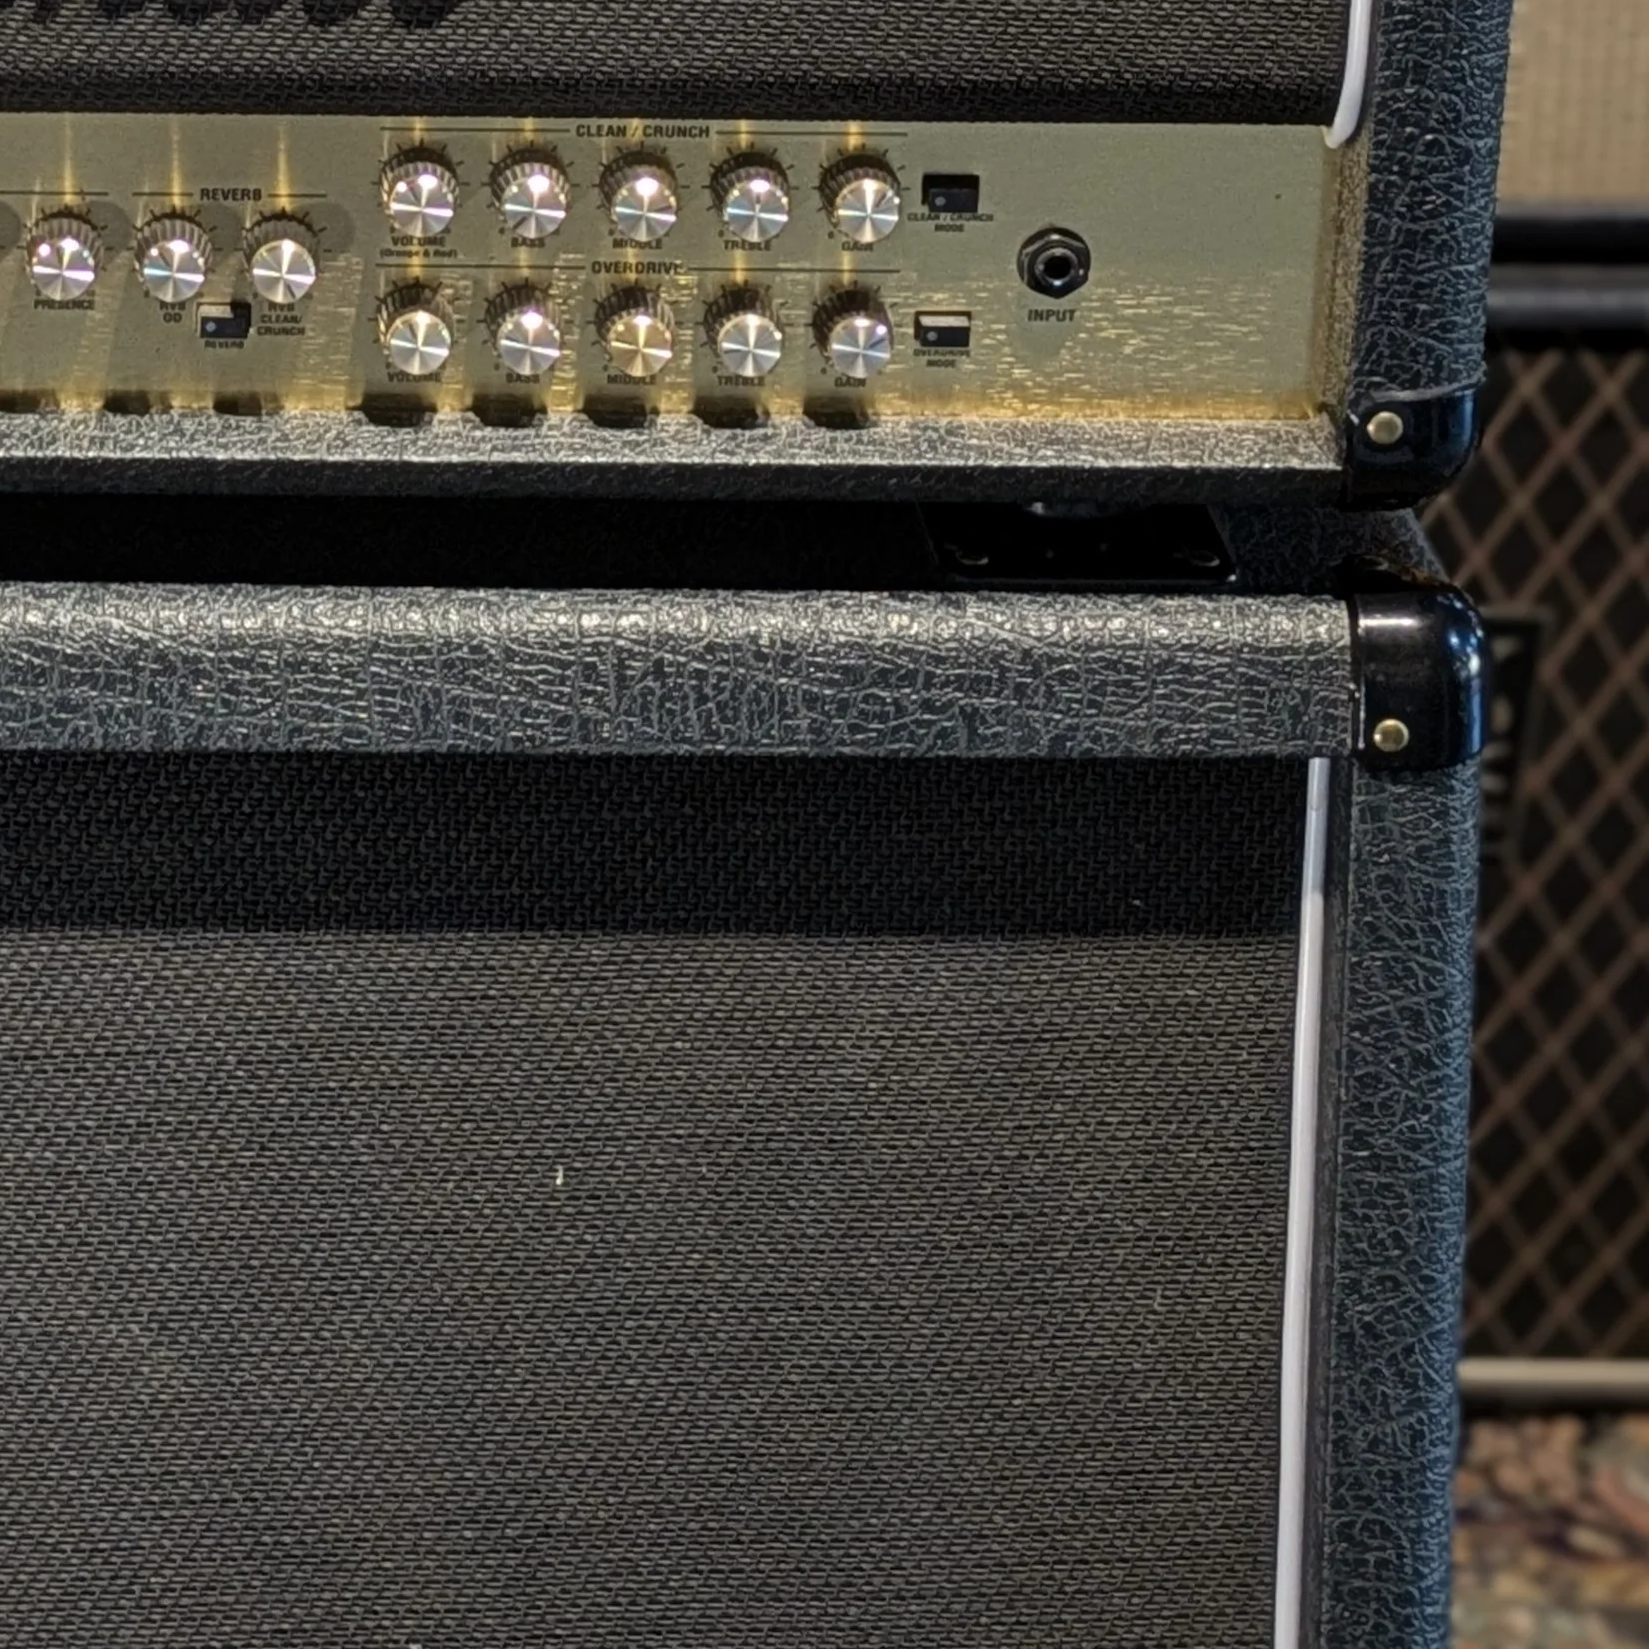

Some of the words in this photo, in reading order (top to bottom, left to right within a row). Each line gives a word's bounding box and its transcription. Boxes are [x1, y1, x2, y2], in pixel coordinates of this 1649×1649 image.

[576, 124, 628, 138] CLEAN
[642, 125, 710, 139] CRUNCH
[200, 188, 262, 201] REVERB
[934, 224, 964, 233] MODE
[391, 236, 446, 247] VOLUME
[511, 237, 545, 248] BASS
[723, 239, 772, 251] TREBLE
[592, 261, 684, 275] OVERDRIVE
[33, 298, 95, 310] PRESENCE
[163, 312, 182, 324] OD
[1027, 308, 1078, 323] INPUT
[257, 326, 306, 336] CRUNCH
[387, 371, 442, 383] VOLUME
[506, 373, 540, 384] BASS
[607, 373, 657, 385] MIDDLE
[716, 375, 765, 387] TREBLE
[834, 376, 867, 388] GAIN
